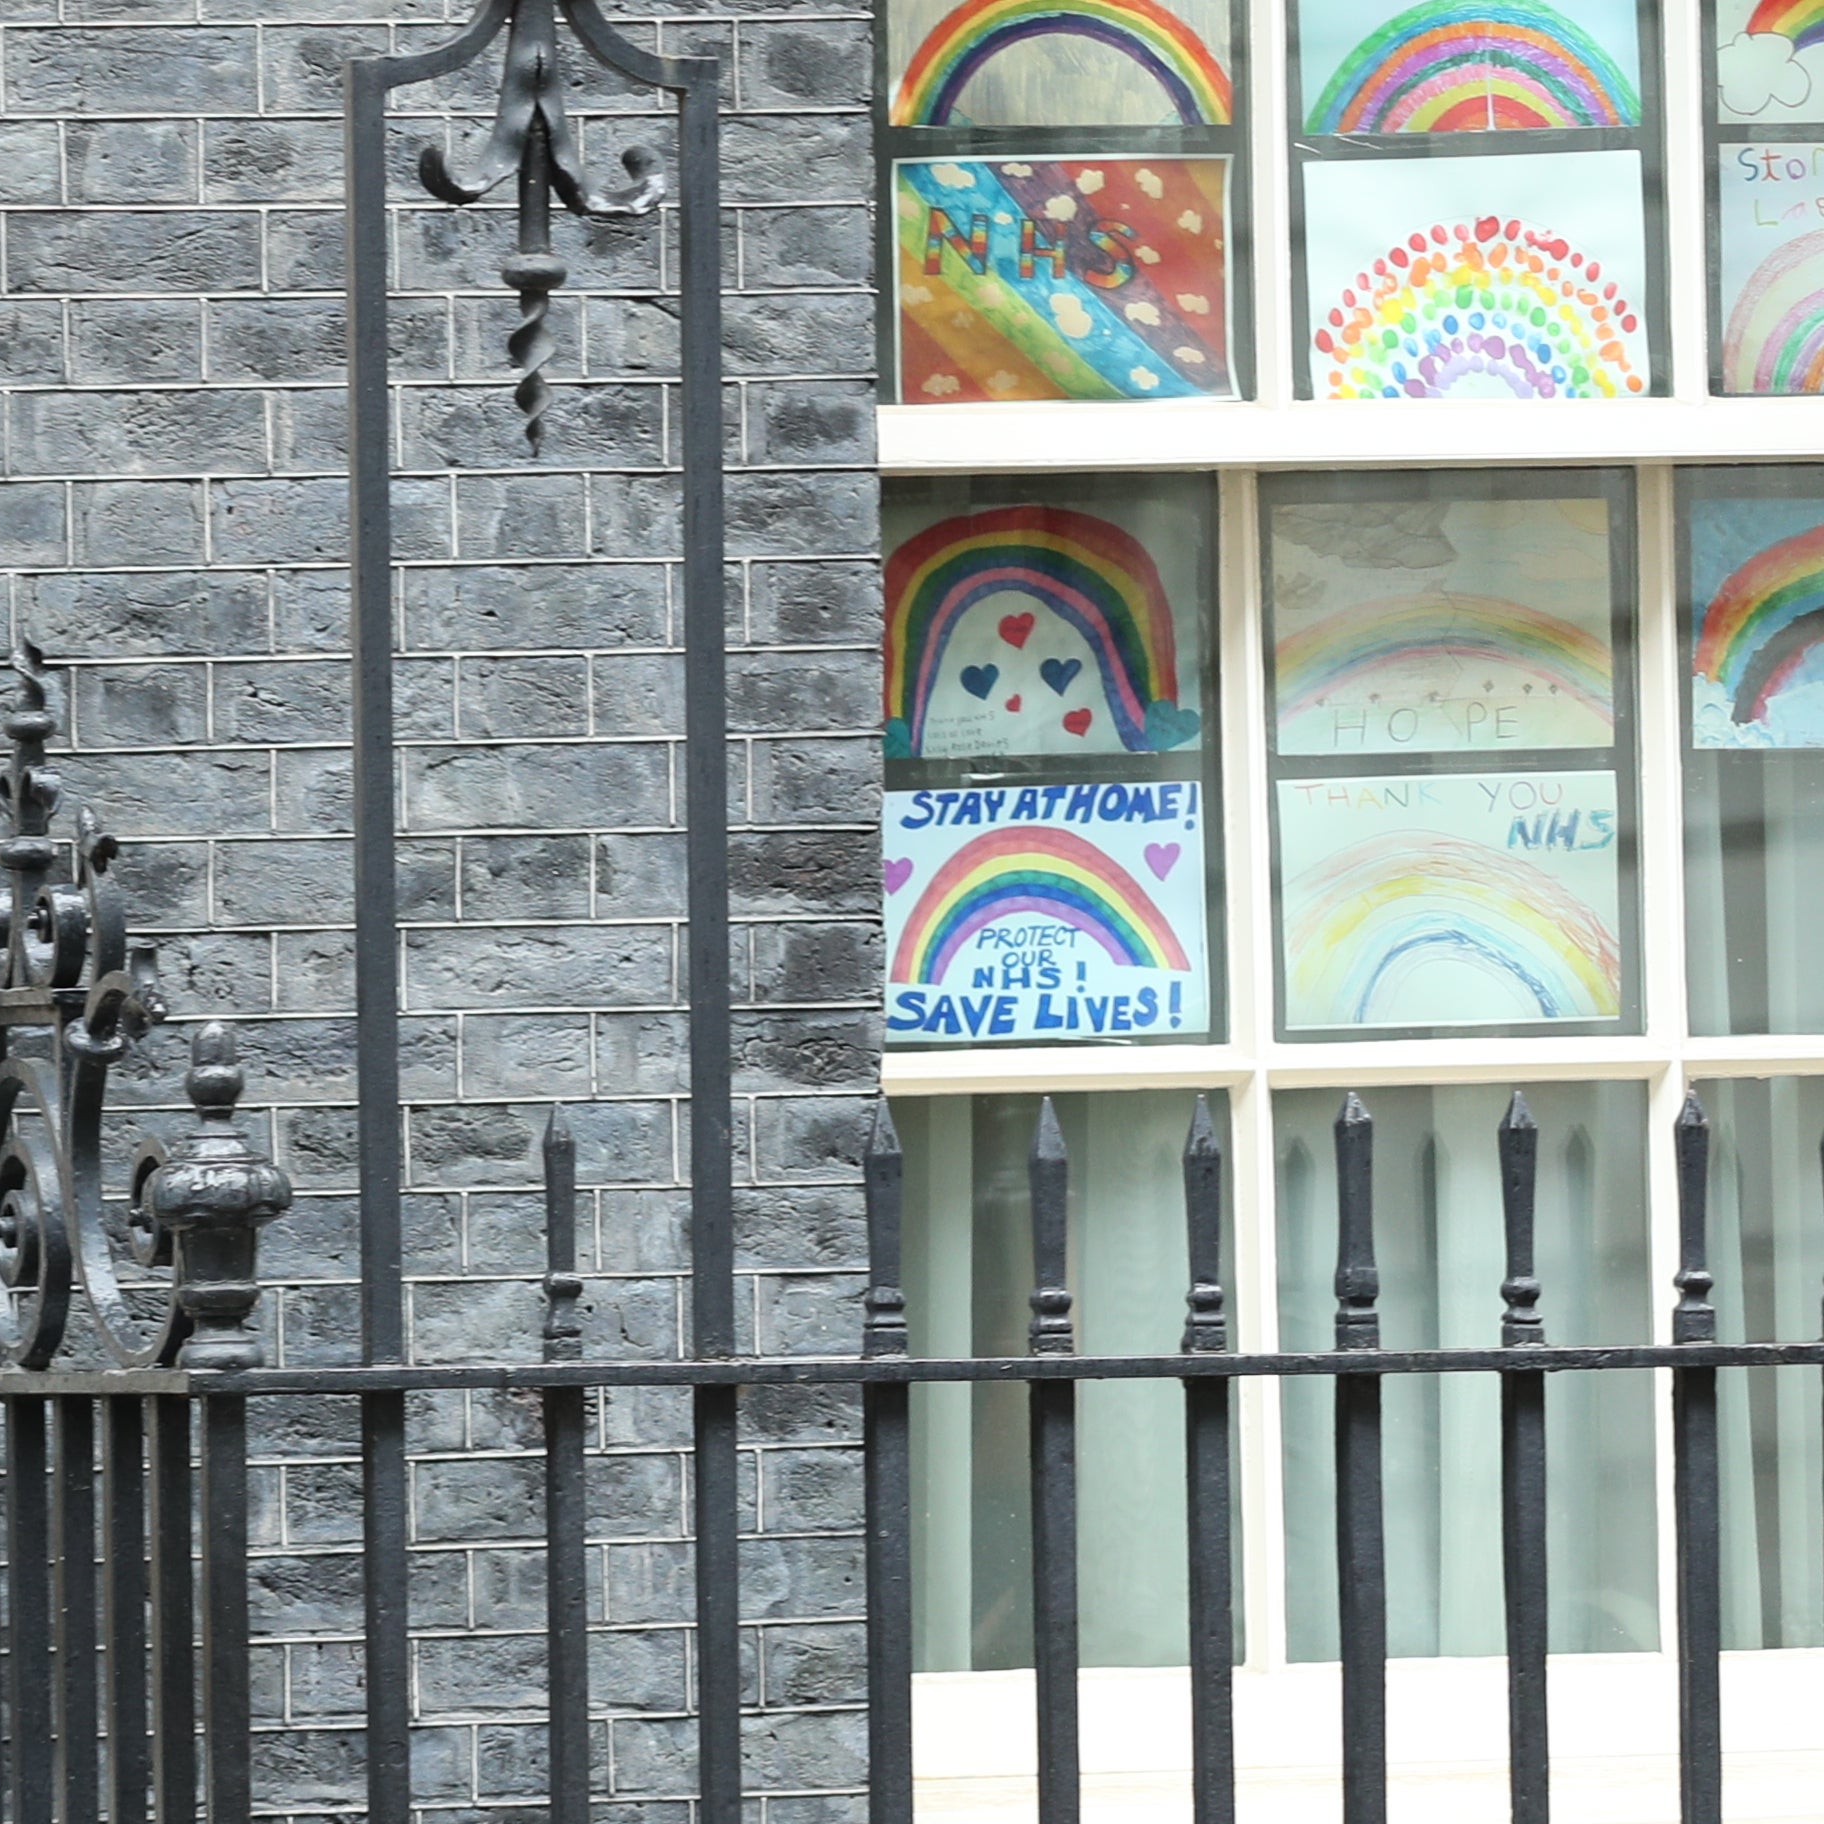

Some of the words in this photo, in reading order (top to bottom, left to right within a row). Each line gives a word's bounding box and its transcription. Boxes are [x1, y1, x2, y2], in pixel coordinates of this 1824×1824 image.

[924, 207, 1135, 289] NHS
[900, 789, 1006, 829] STAY
[1294, 782, 1442, 811] THANK
[1478, 781, 1563, 812] YOU
[1507, 808, 1616, 851] NHS
[976, 924, 1082, 949] PROTECT
[1002, 949, 1057, 967] OUR
[887, 991, 1019, 1037] SAVE
